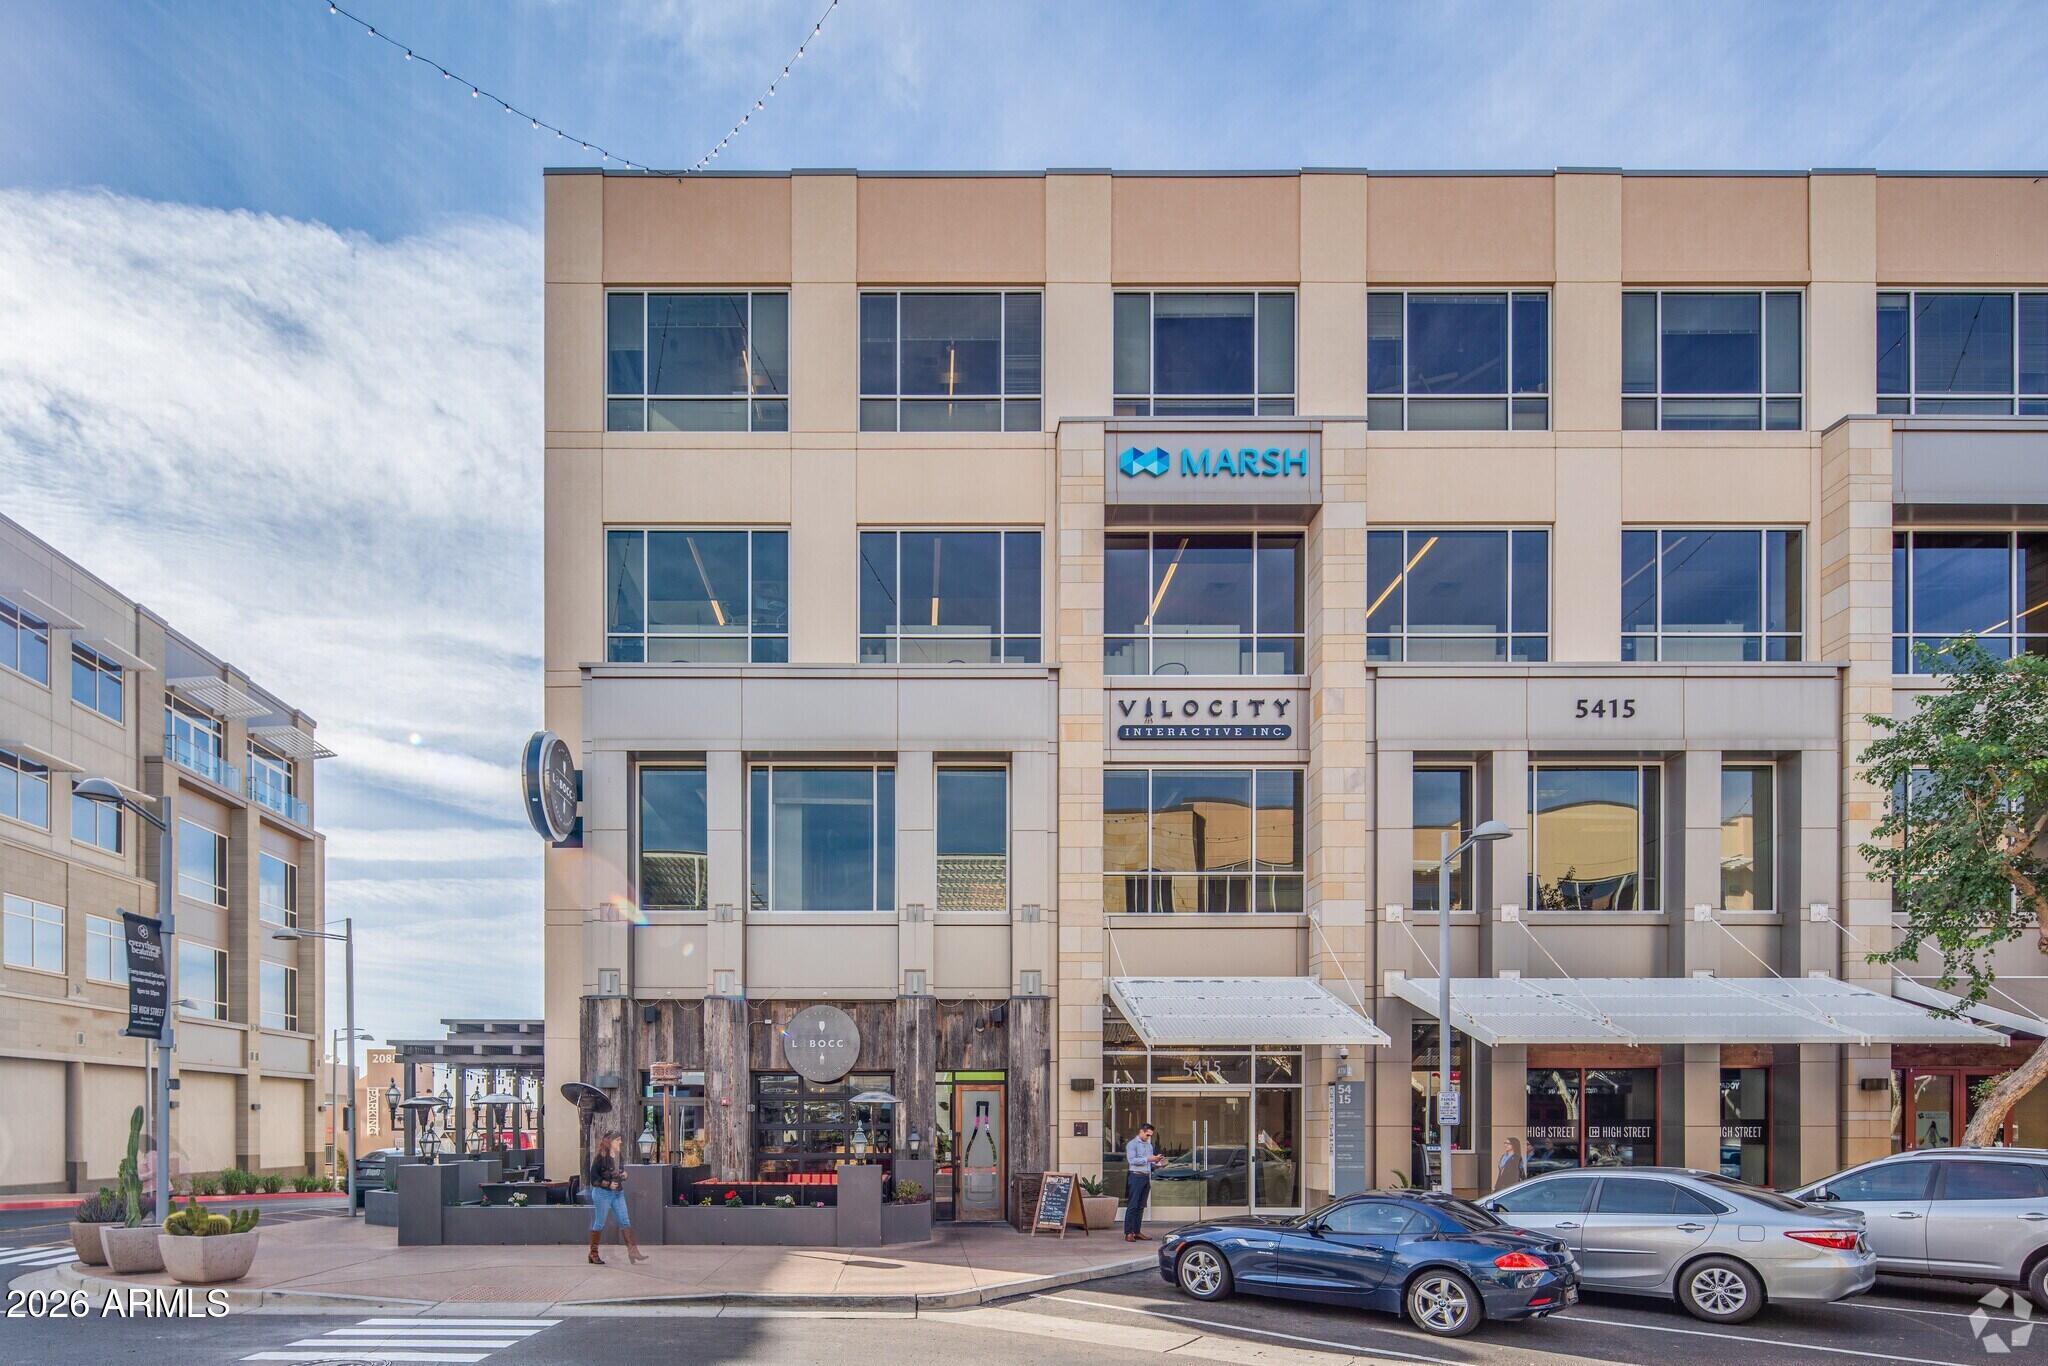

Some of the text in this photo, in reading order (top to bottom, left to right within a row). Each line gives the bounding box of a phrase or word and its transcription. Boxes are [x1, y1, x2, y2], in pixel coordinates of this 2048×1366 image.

[1181, 447, 1307, 477] MARSH
[1118, 697, 1291, 719] VILOCITY
[1575, 699, 1636, 718] 5415
[1125, 727, 1286, 736] INTERACTIVE INC.
[372, 1054, 395, 1064] 208
[1183, 1060, 1221, 1077] 5415
[1338, 1084, 1352, 1094] 54
[1338, 1095, 1351, 1104] 15
[368, 1088, 377, 1136] PARKING
[1527, 1126, 1576, 1138] HIGH STREET
[1602, 1126, 1651, 1138] HIGH STREET
[1720, 1126, 1762, 1138] IGH STREET
